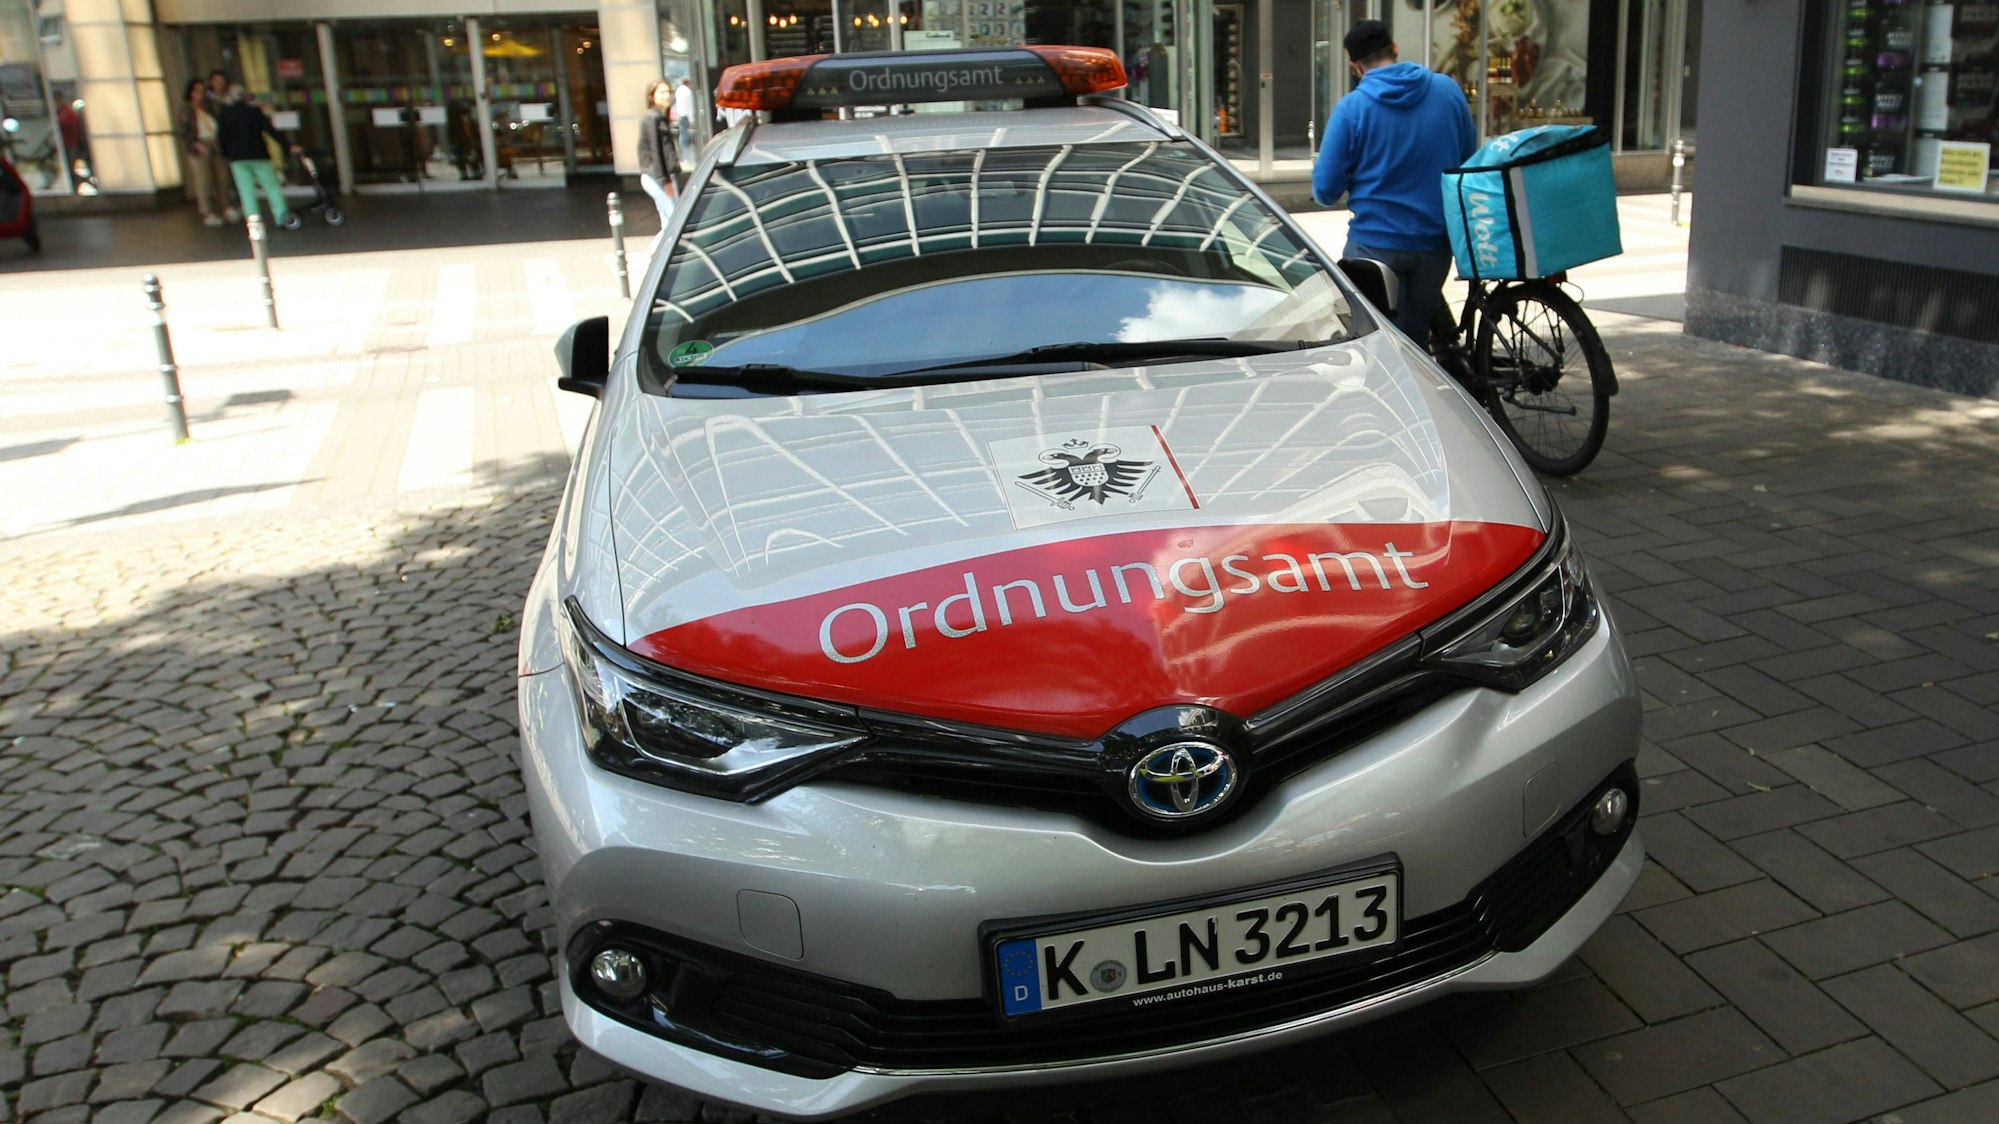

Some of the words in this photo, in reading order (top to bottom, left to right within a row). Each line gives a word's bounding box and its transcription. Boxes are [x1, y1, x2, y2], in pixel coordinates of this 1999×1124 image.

[849, 65, 1003, 93] Ordnungsamt
[1468, 192, 1499, 269] Wolt
[819, 541, 1430, 665] Ordnungsamt
[1044, 940, 1089, 1001] K
[1134, 915, 1220, 985] LN
[1235, 885, 1388, 964] 3213
[1014, 985, 1028, 1002] D
[1133, 970, 1283, 1007] www.autohaus-karst.de
